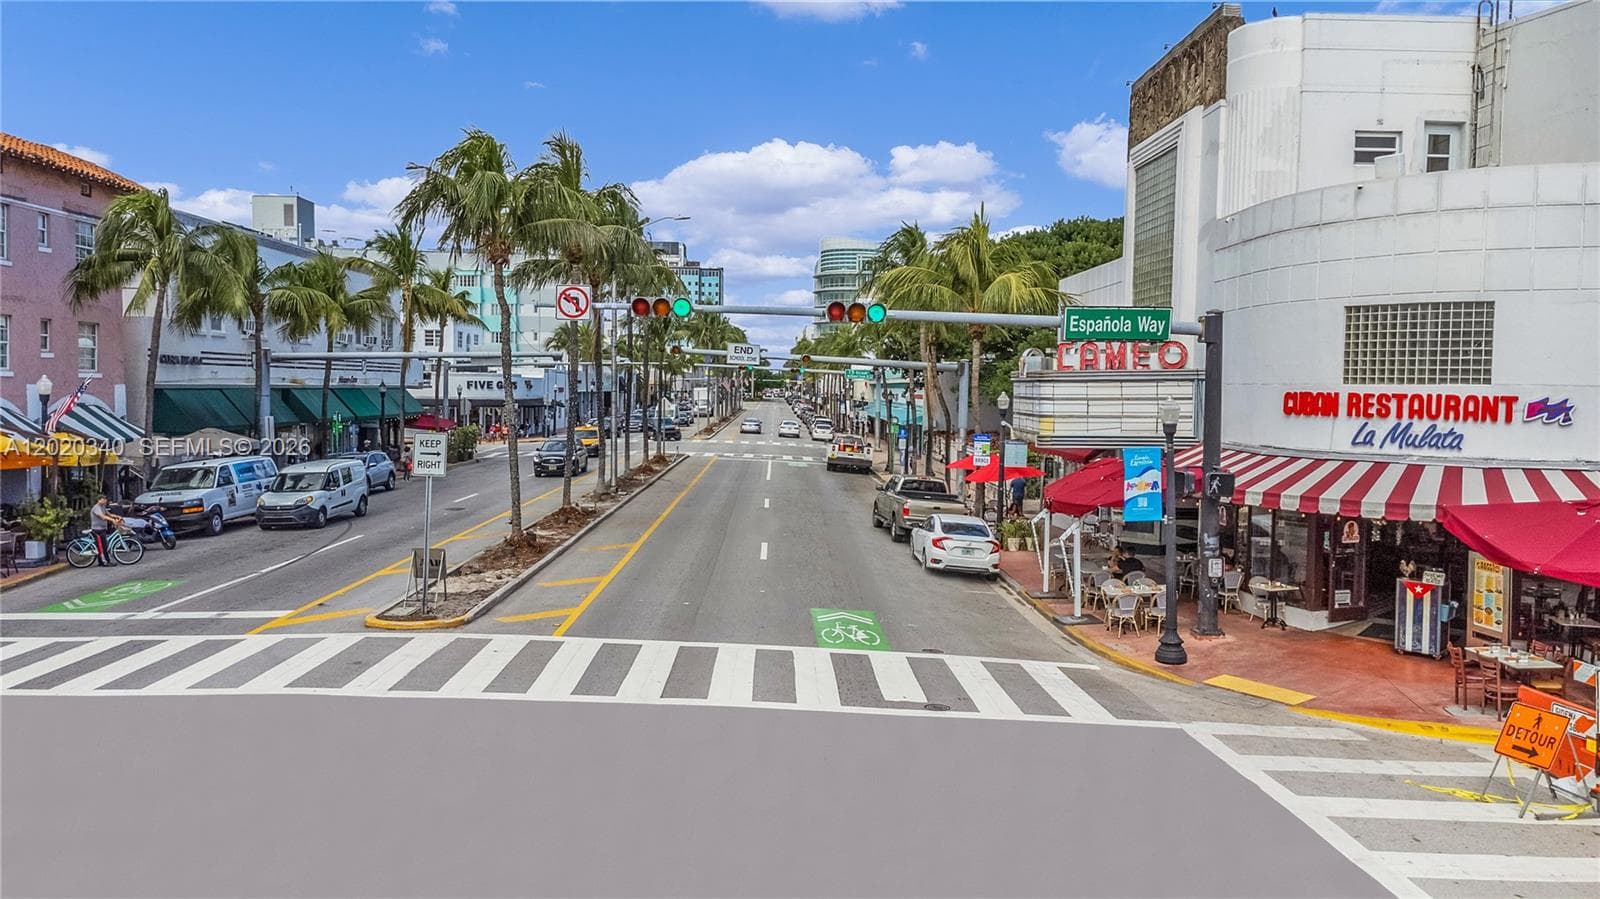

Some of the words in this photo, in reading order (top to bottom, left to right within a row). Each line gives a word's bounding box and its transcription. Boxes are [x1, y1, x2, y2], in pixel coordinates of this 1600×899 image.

[1069, 315, 1131, 335] Española
[1137, 315, 1166, 336] Way
[734, 346, 754, 355] END
[1056, 340, 1188, 371] CAMEO
[466, 380, 494, 390] FIVE
[496, 381, 518, 390] GS
[1283, 391, 1339, 417] CUBAN
[1346, 392, 1519, 424] RESTAURANT
[419, 440, 442, 449] KEEP
[1351, 421, 1376, 447] La
[1379, 421, 1464, 450] Mulata
[417, 460, 441, 470] RIGHT
[1506, 723, 1557, 750] DETOUR
